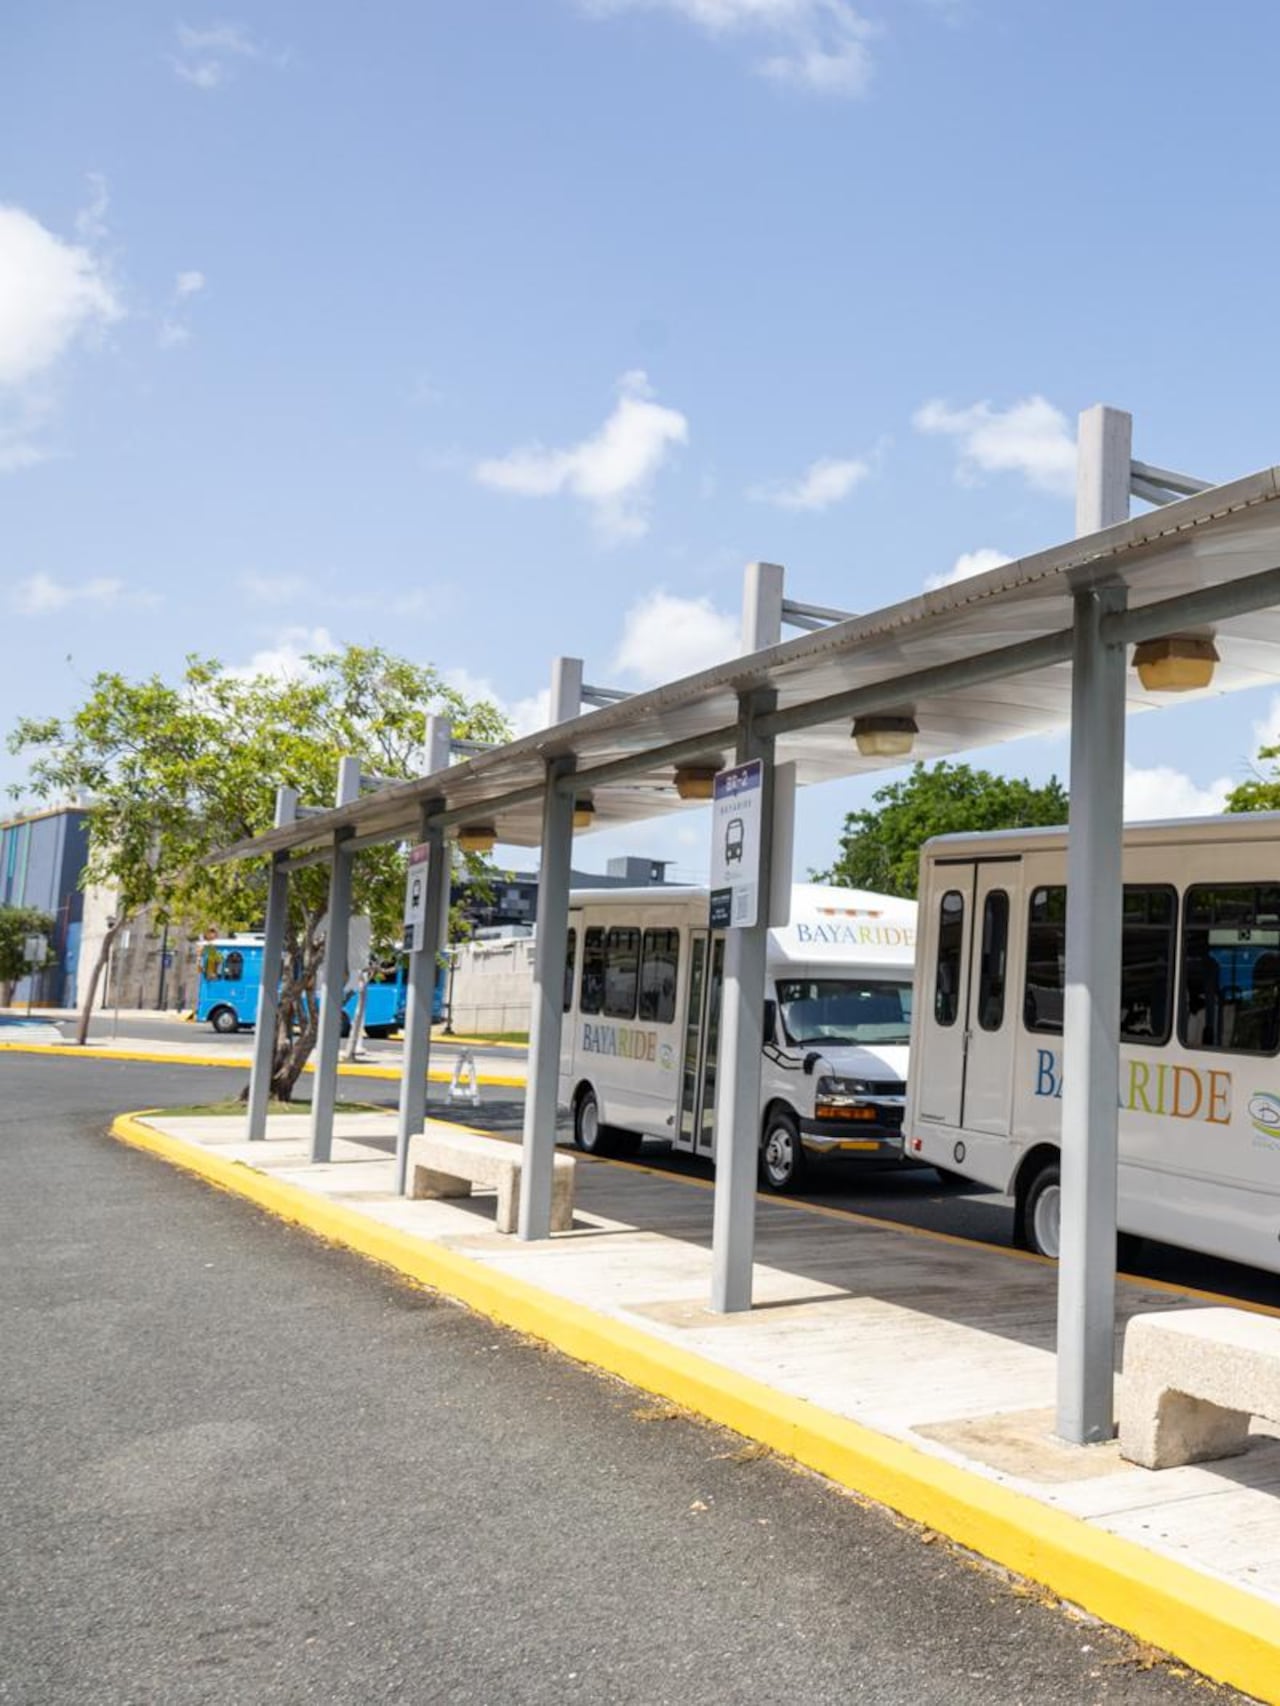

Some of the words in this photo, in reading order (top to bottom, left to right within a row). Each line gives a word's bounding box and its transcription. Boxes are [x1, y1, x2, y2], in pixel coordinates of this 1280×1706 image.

[796, 923, 917, 946] BAYARIDE
[582, 1023, 657, 1062] BAYARIDE
[1034, 1049, 1232, 1126] BRIDE
